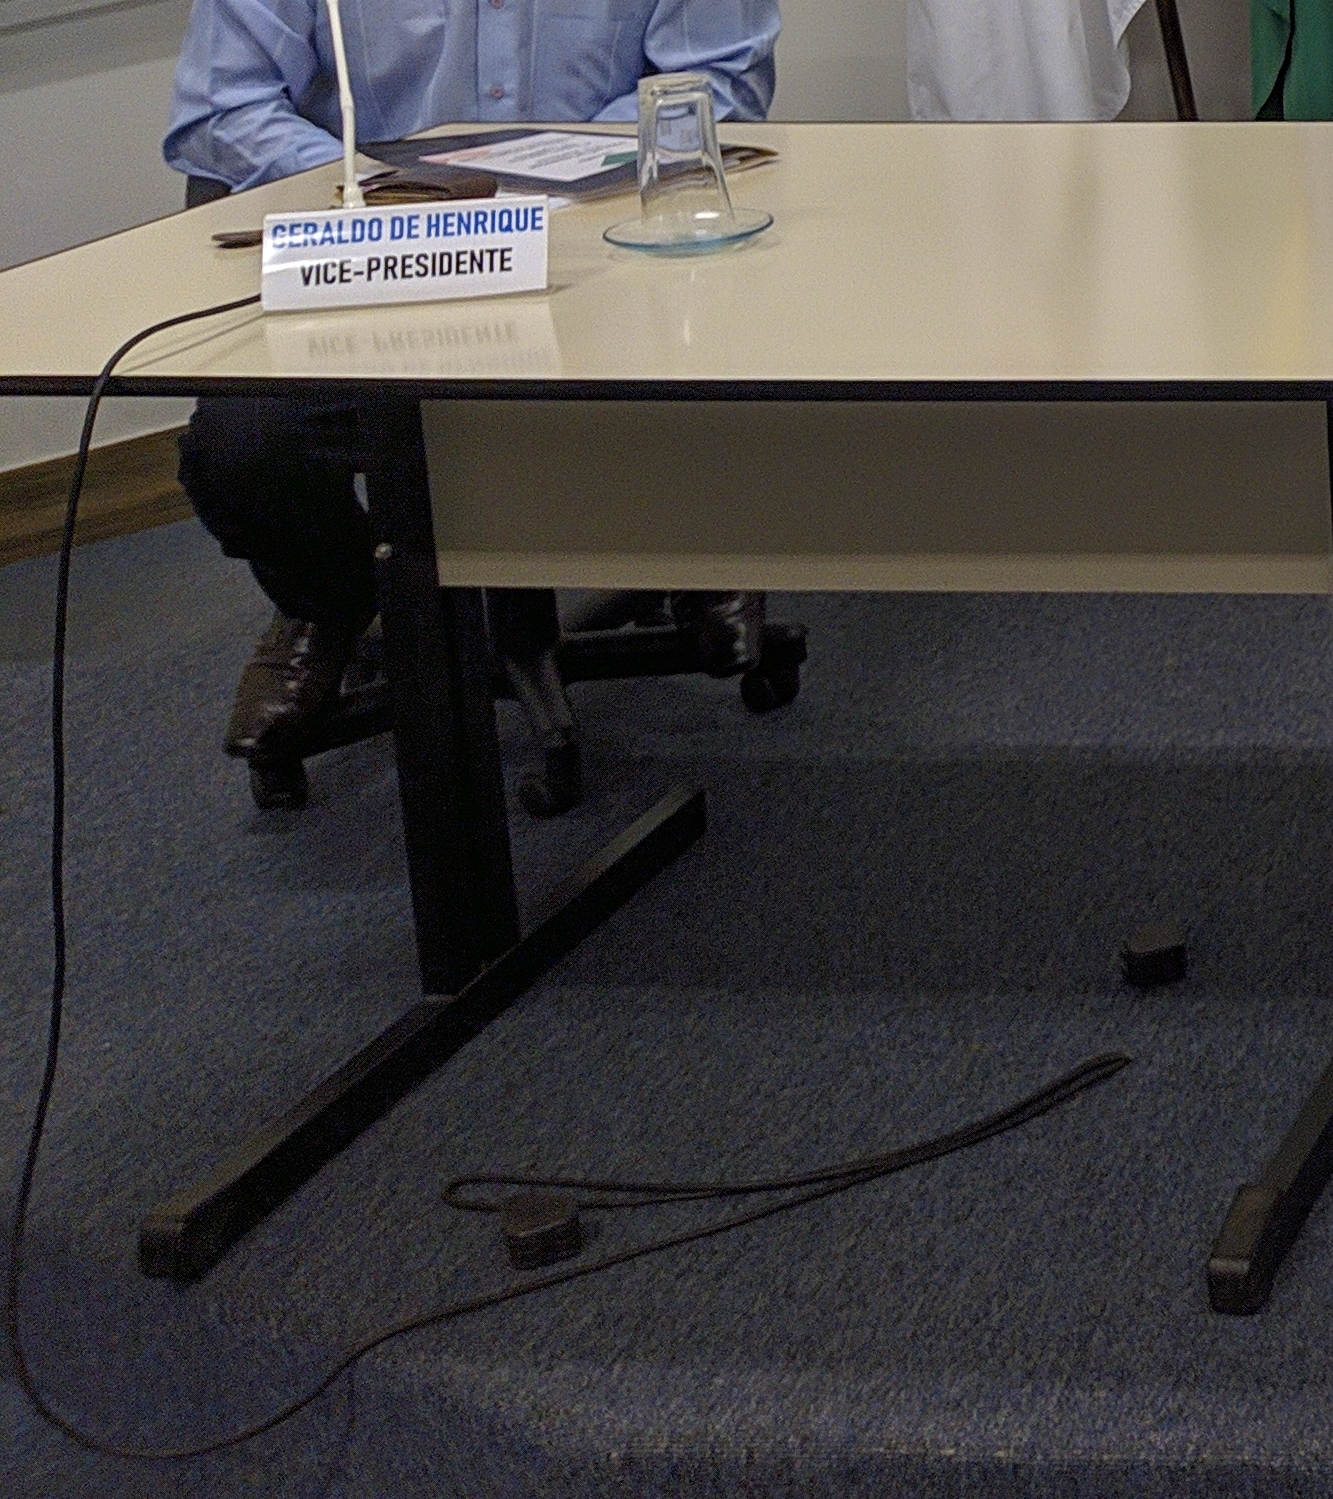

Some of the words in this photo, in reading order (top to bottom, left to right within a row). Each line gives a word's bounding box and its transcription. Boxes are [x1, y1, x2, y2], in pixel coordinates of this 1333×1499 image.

[271, 216, 383, 249] GERALDO
[389, 214, 420, 242] DE
[426, 205, 544, 239] HENRIQUE
[300, 246, 514, 287] VICE-PRESIDENTE
